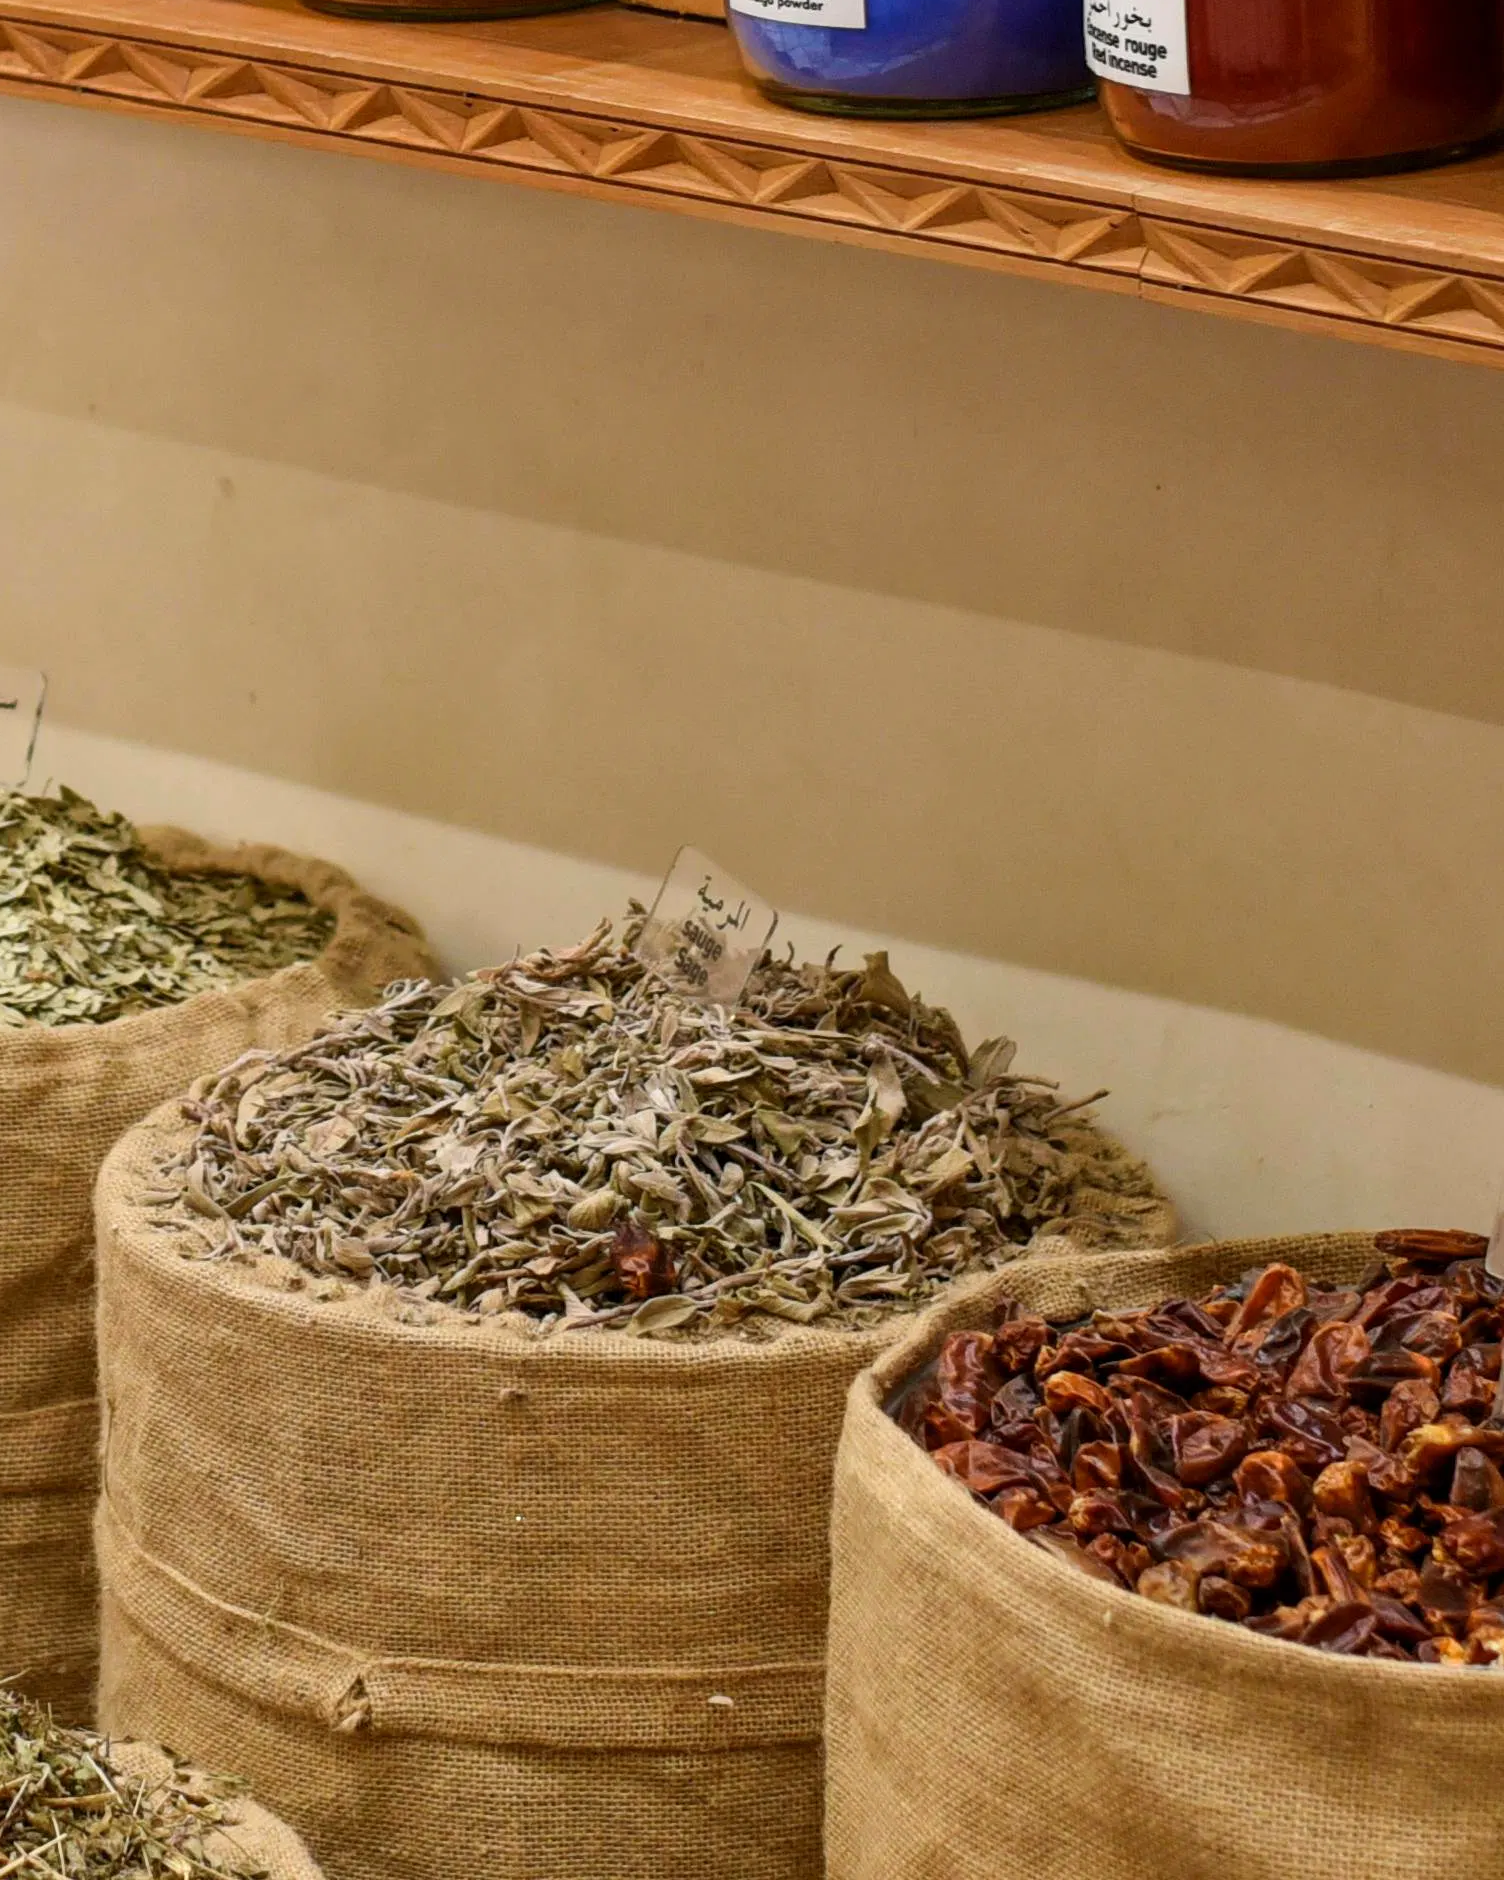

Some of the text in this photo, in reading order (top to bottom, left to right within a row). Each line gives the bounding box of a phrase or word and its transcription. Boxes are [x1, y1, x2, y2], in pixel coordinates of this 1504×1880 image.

[1107, 48, 1157, 78] incense
[1124, 36, 1168, 60] rouge
[675, 947, 709, 987] Sage
